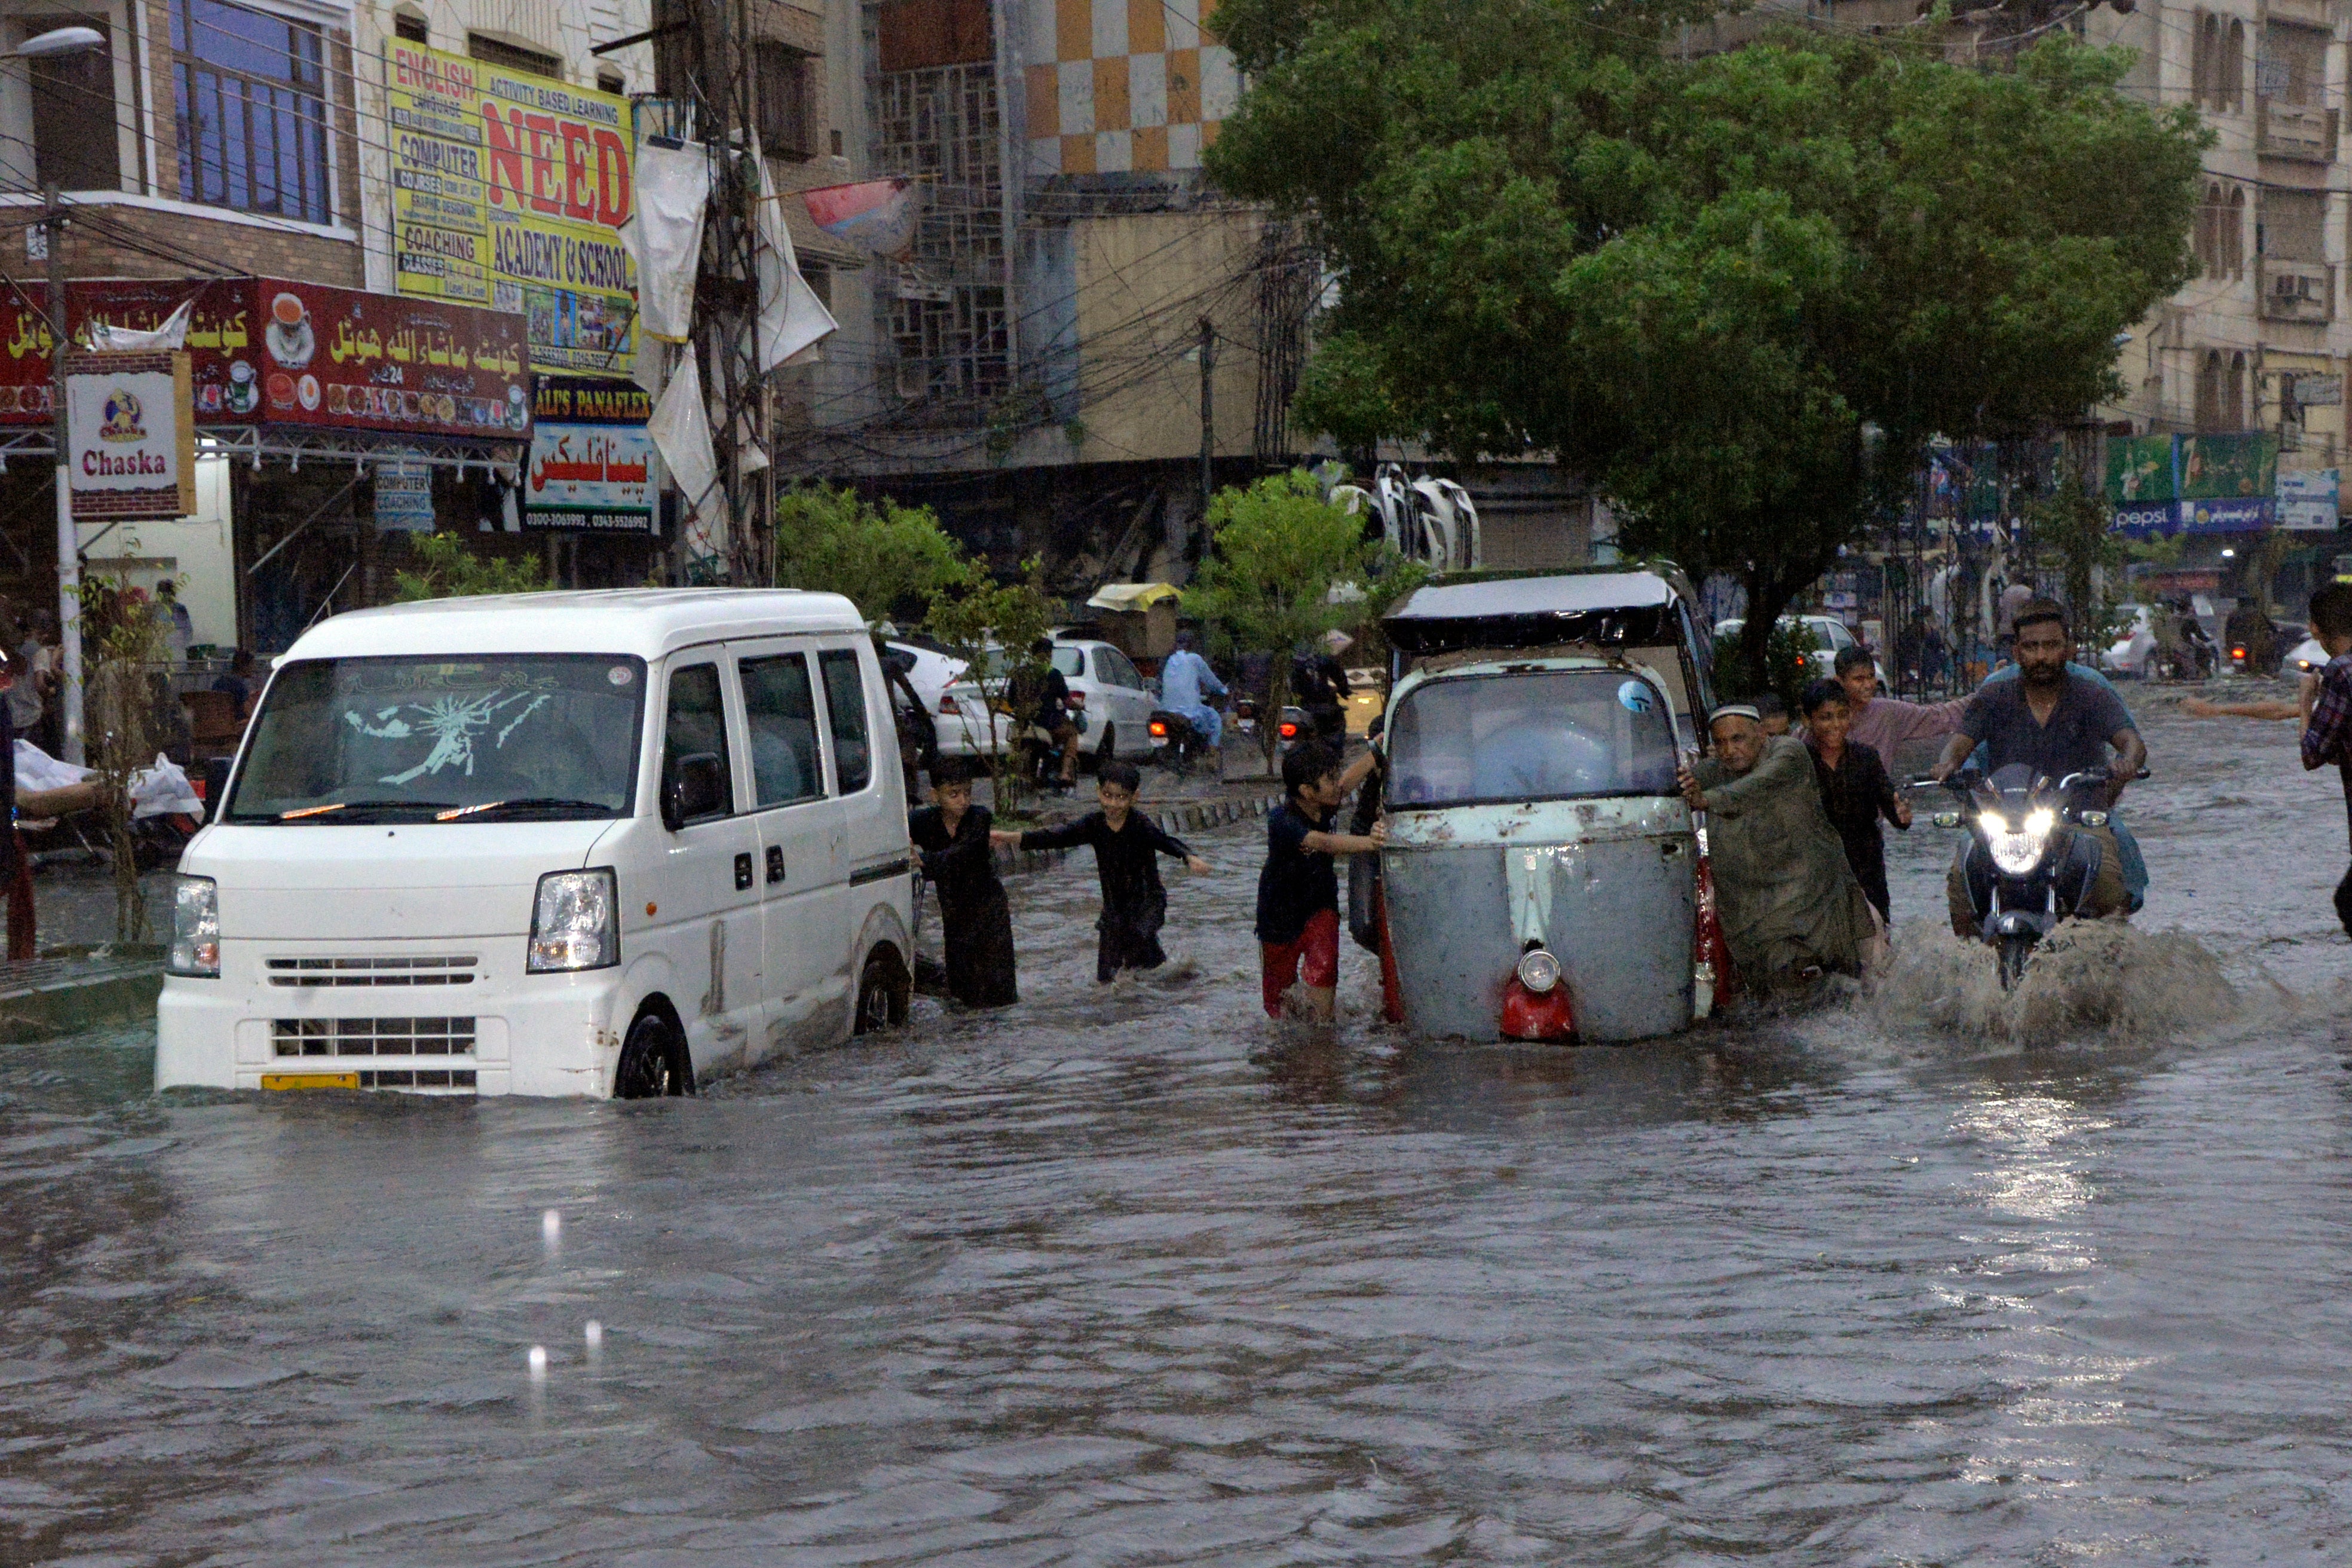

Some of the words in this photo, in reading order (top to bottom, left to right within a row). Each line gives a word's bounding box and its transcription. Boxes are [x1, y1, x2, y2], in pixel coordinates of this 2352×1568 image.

[396, 48, 475, 102] ENGLISH
[411, 92, 461, 119] LANGUAGE
[490, 76, 535, 103] ACTIVITY
[537, 88, 569, 112] BASED
[571, 97, 619, 124] LEARNING
[400, 133, 479, 180] COMPUTER
[482, 101, 630, 228] NEED
[400, 170, 441, 195] COURSES
[405, 226, 476, 261] COACHING
[494, 225, 562, 281] ACADEMY
[578, 240, 631, 291] SCHOOL
[403, 253, 445, 278] CLASSES
[577, 390, 652, 419] PANAFLEX
[82, 449, 166, 476] Chaska
[2116, 507, 2169, 528] pepsi
